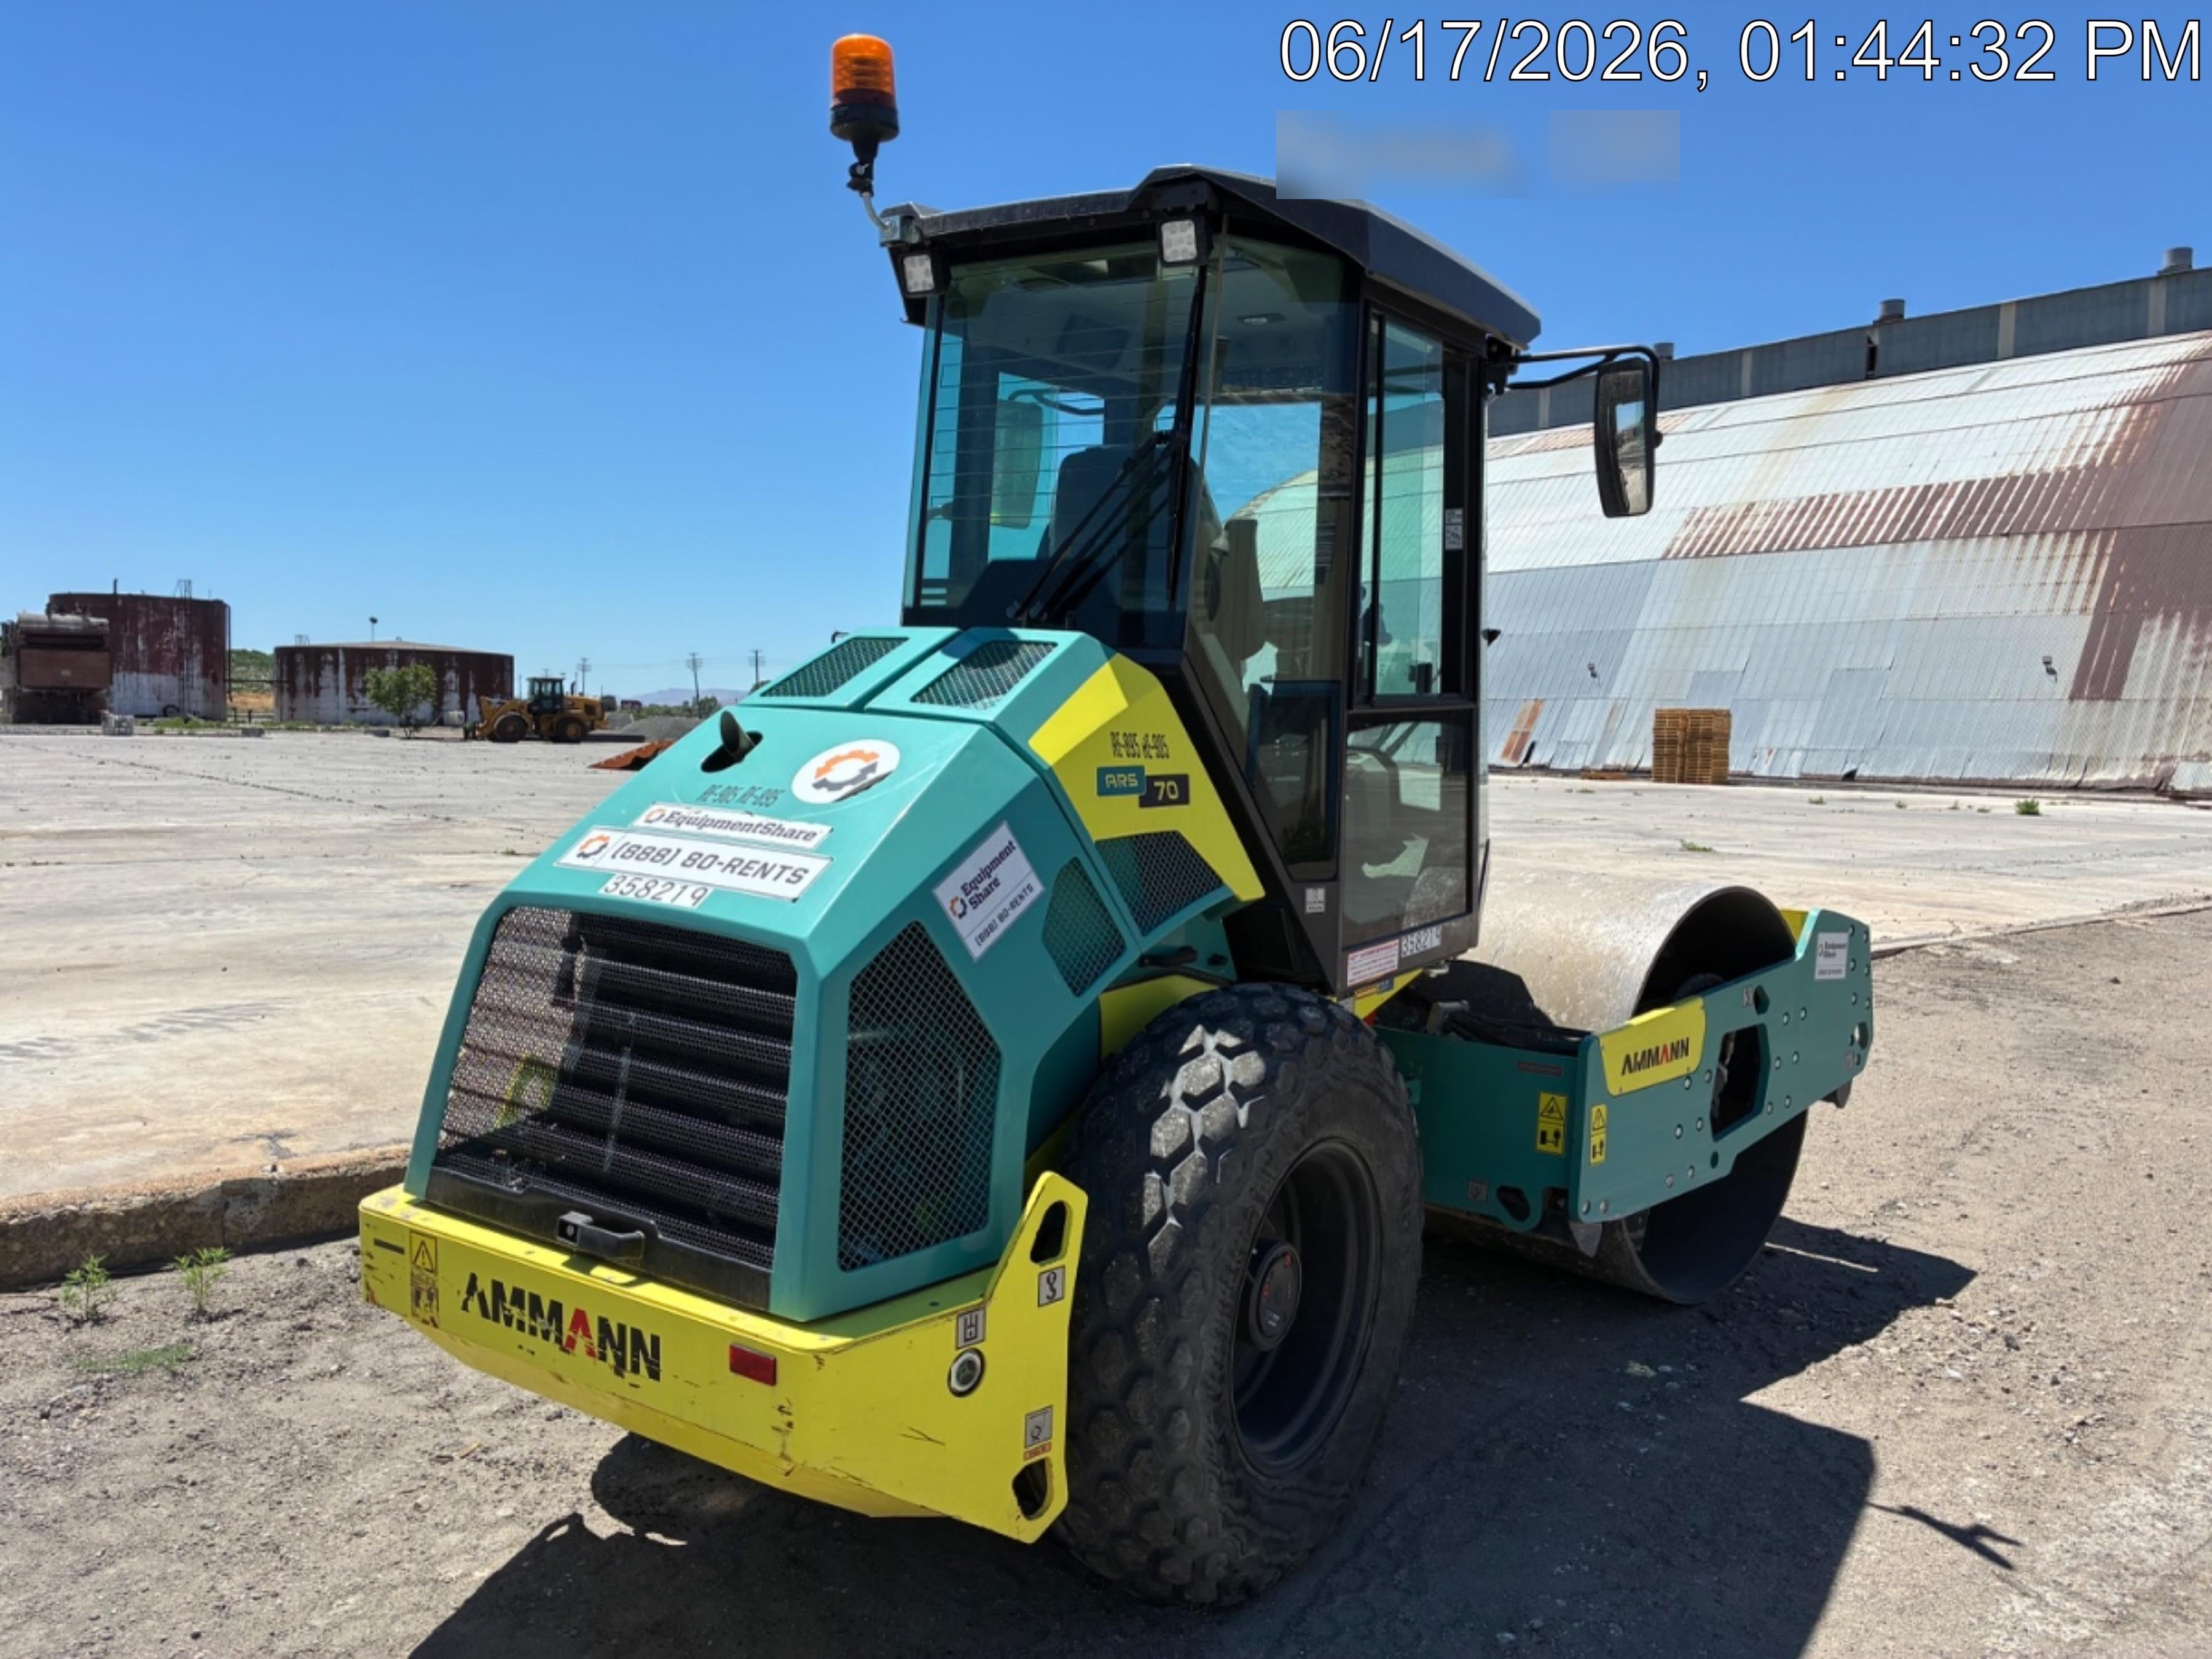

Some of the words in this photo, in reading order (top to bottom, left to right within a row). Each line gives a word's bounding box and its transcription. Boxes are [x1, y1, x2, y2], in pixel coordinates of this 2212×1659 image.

[1105, 774, 1138, 788] ARS
[1153, 781, 1179, 801] 70
[663, 810, 817, 841] EquipmentShare
[611, 842, 682, 866] (888)
[680, 851, 809, 885] 80-RENTS
[960, 840, 1016, 897] Equipment
[604, 875, 708, 907] 358219
[968, 877, 1001, 909] Share
[1621, 1037, 1690, 1077] AMMANN
[460, 1271, 662, 1382] AMMANN
